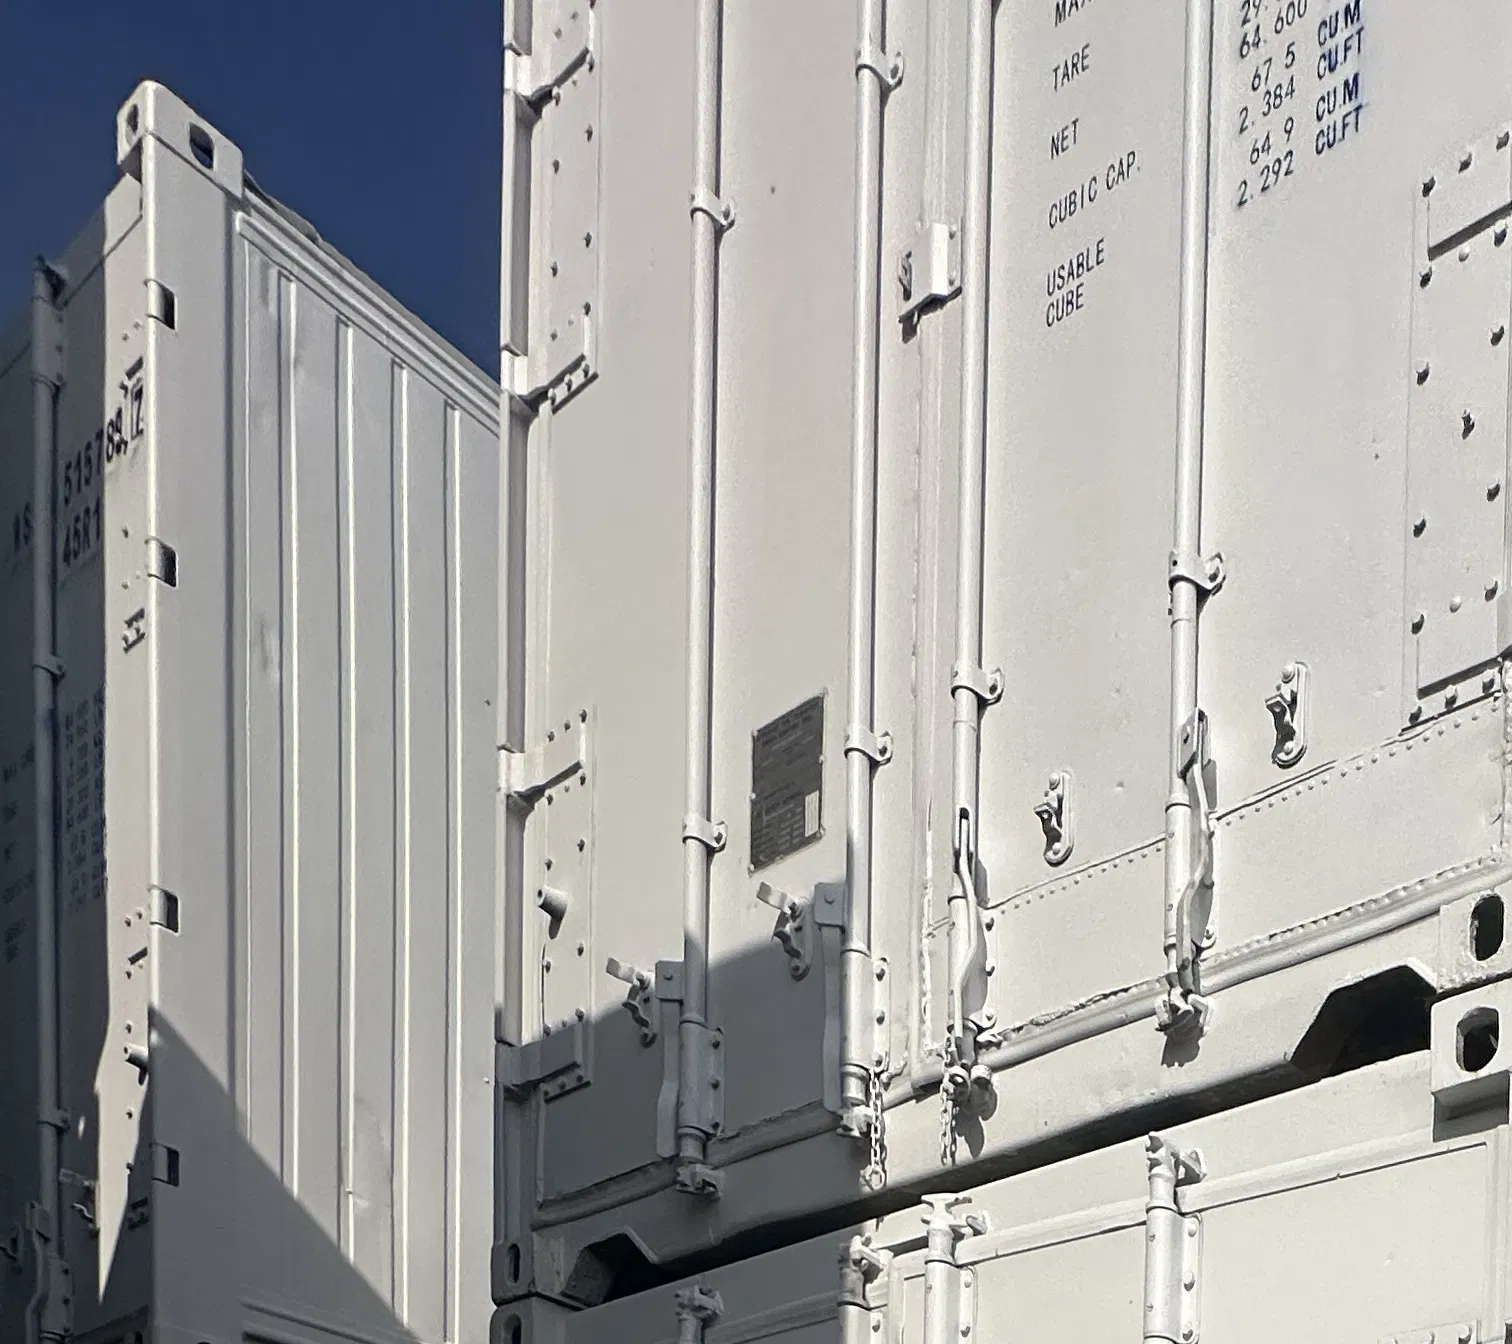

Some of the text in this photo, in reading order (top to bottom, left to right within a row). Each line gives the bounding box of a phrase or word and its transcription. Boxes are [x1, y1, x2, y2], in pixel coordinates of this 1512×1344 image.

[1053, 43, 1090, 91] TARE
[1051, 117, 1079, 160] NET
[1049, 176, 1098, 228] CUBIC
[1047, 238, 1104, 296] USABLE
[1046, 283, 1084, 327] CUBE
